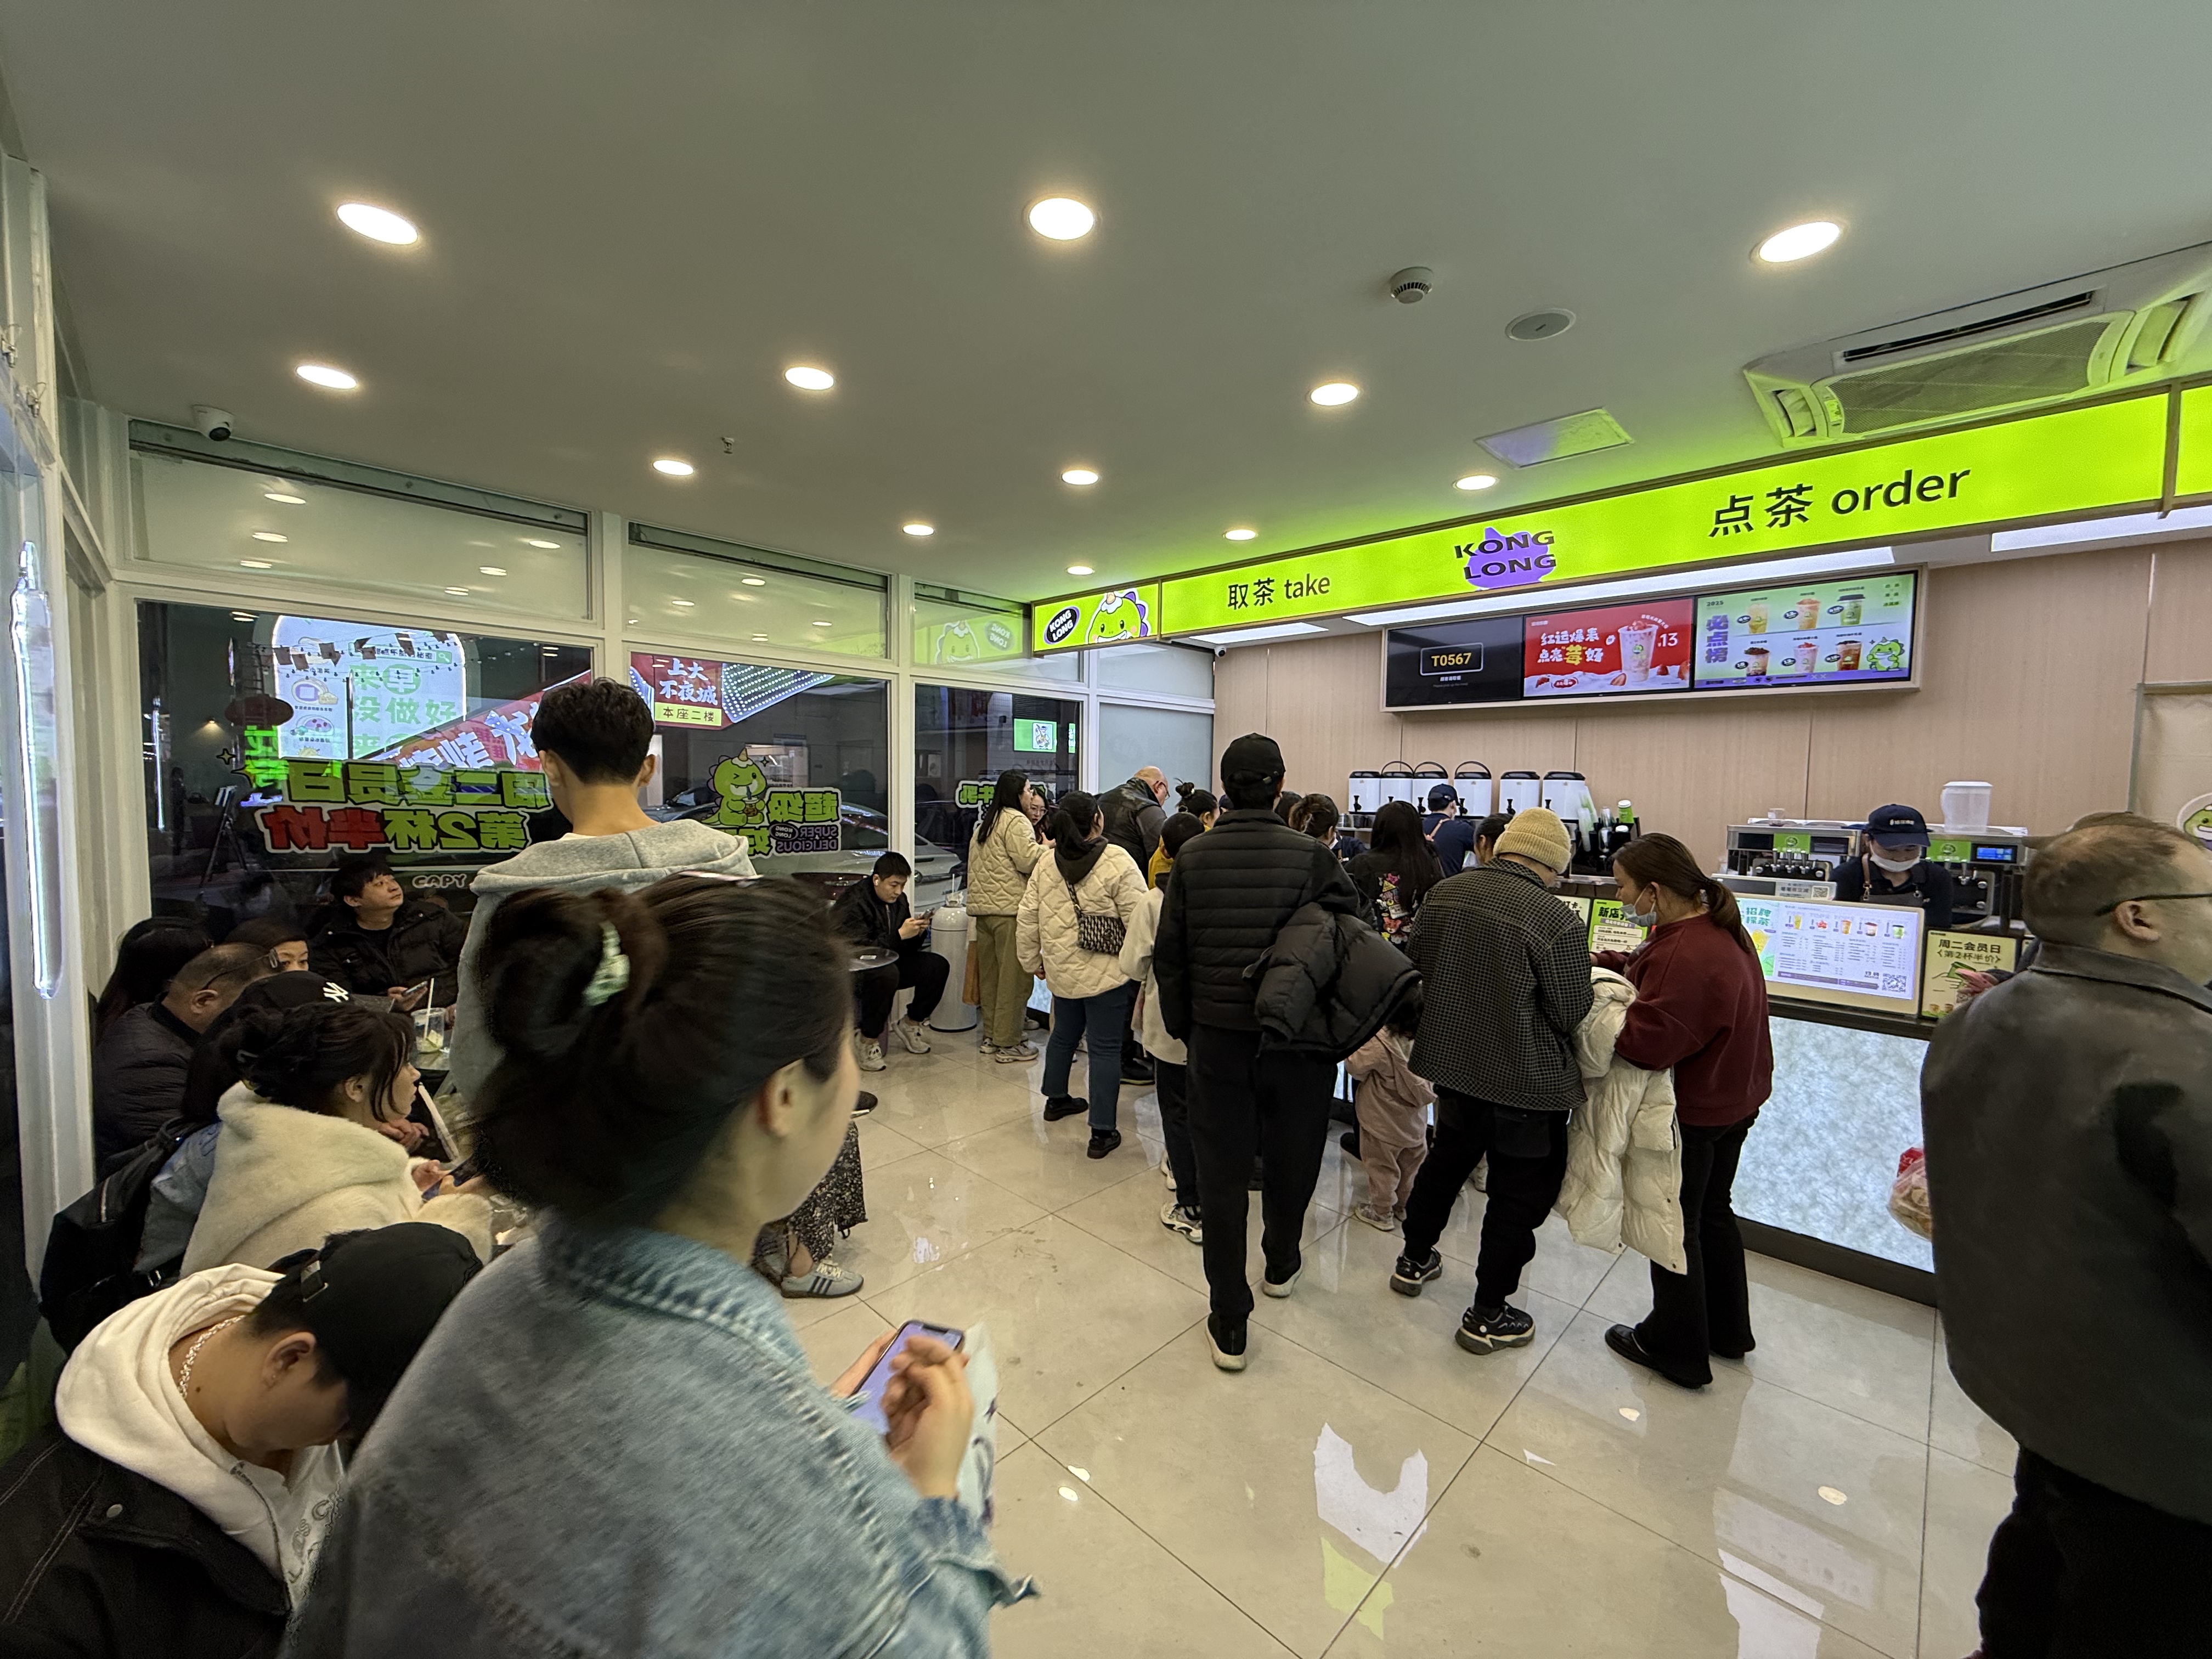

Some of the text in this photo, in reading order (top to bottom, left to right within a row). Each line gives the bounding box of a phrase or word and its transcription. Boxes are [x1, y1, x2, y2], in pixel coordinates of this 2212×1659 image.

[1708, 469, 1971, 538] 点茶 order
[1454, 531, 1555, 558] KONG
[1464, 554, 1556, 579] LONG
[1228, 573, 1330, 610] 取茶 take
[1049, 610, 1072, 632] KONG
[1052, 620, 1074, 641] LONG
[1705, 614, 1728, 663] 必点榜
[667, 658, 709, 681] 上大
[1431, 652, 1472, 667] T0567
[659, 680, 718, 706] 不夜城
[353, 696, 456, 725] 没做好
[663, 707, 714, 722] 本座二楼
[1938, 939, 2001, 953] 周二会员日
